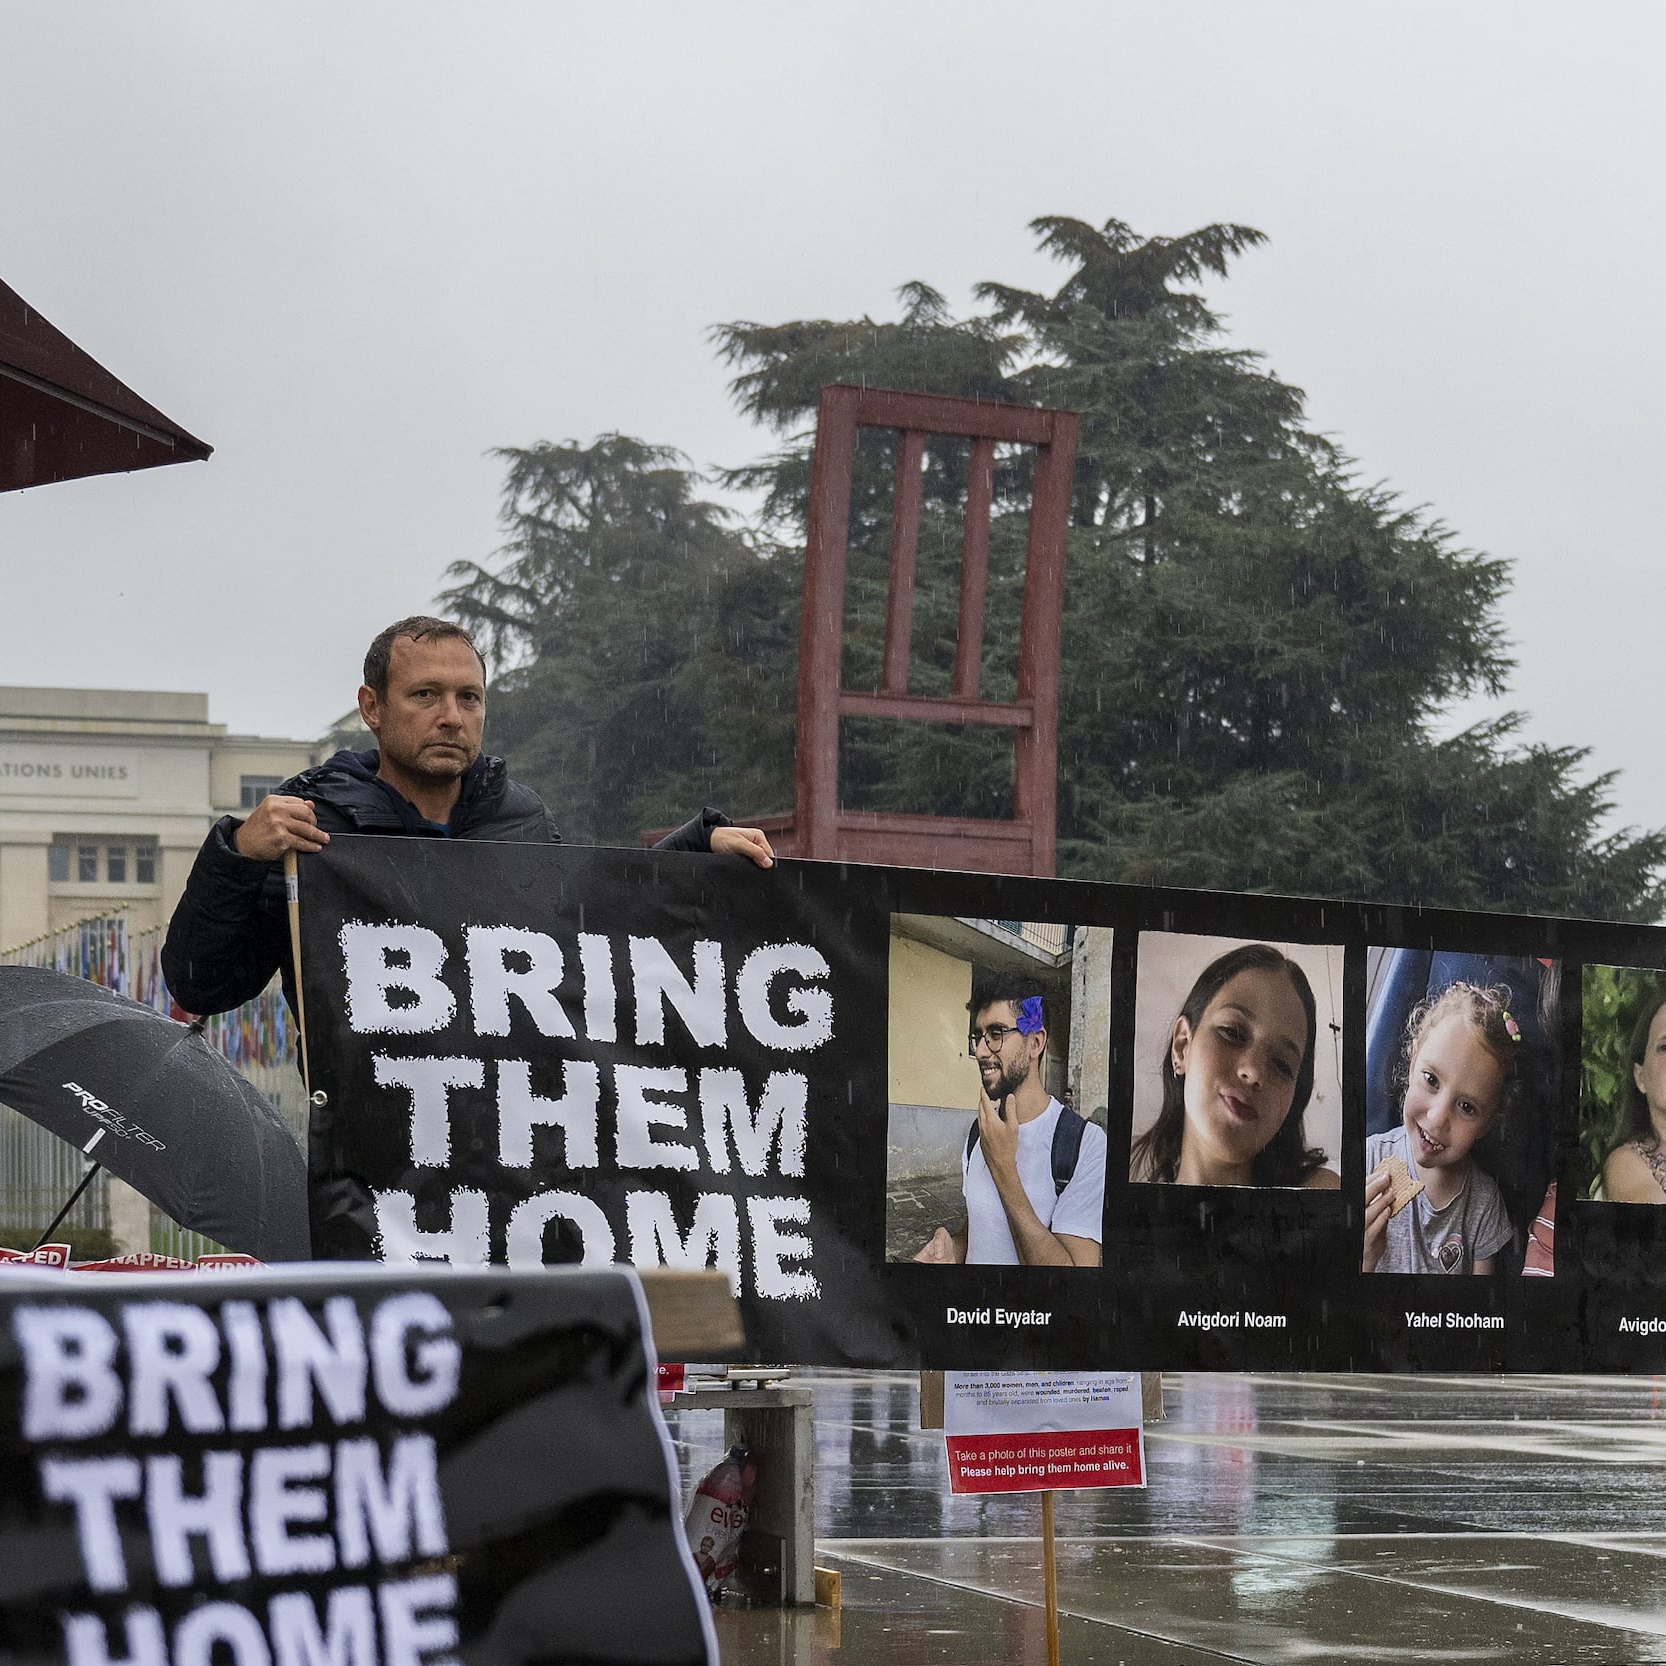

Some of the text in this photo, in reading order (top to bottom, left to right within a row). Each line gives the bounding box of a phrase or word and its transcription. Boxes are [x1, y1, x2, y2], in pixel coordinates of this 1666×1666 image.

[71, 764, 129, 780] UNIES
[338, 919, 834, 1053] BRING
[62, 1082, 166, 1151] PROFILTER
[83, 1106, 131, 1140] UPF50+
[372, 1051, 808, 1178] THEM
[370, 1185, 822, 1302] HOME
[947, 1307, 1052, 1328] David Evyatar
[1178, 1311, 1287, 1330] Avigdori Noam
[1405, 1312, 1505, 1329] Yahel Shoham
[11, 1291, 461, 1441] BRING
[955, 1450, 977, 1461] Take
[988, 1449, 1014, 1462] photo
[1017, 1447, 1027, 1459] of
[1029, 1446, 1046, 1459] this
[1048, 1446, 1076, 1459] poster
[1079, 1444, 1096, 1456] and
[1098, 1444, 1124, 1455] share
[1126, 1442, 1132, 1454] it
[960, 1460, 1130, 1477] Please help bring them home alive.
[41, 1434, 450, 1593] THEM
